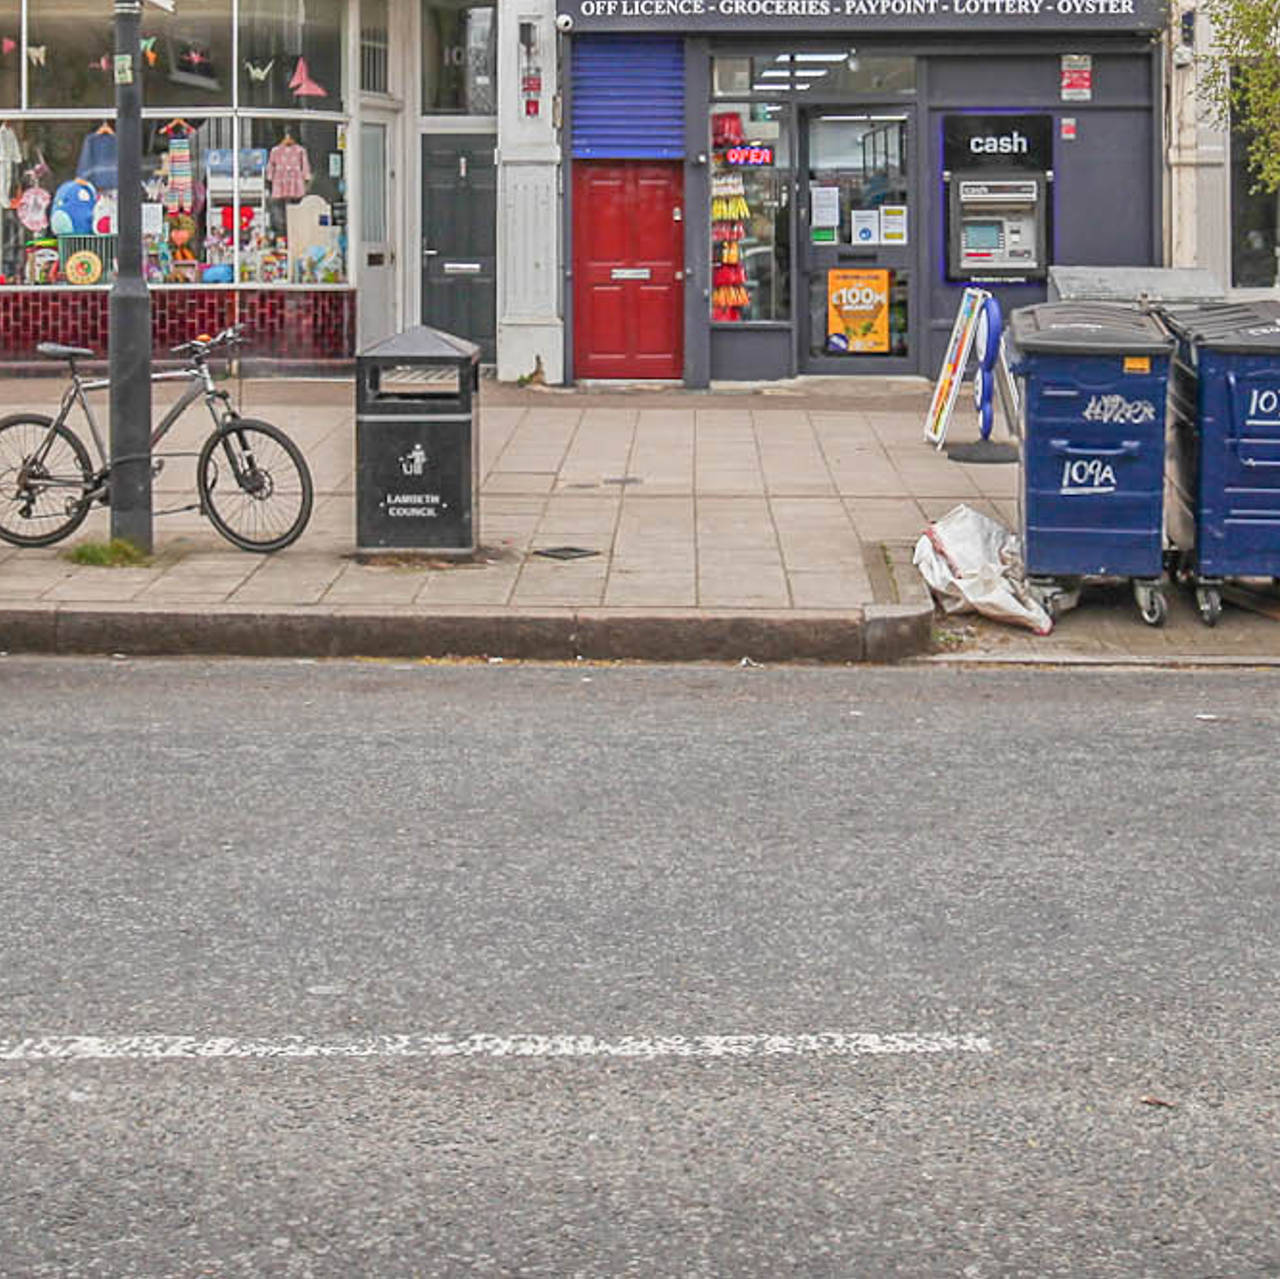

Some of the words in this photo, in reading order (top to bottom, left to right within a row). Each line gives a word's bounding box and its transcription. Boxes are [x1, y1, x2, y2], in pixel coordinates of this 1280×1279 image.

[581, 0, 618, 16] OFF
[969, 131, 1028, 154] cash
[1063, 460, 1116, 487] 109A
[388, 506, 438, 517] COUNCIL
